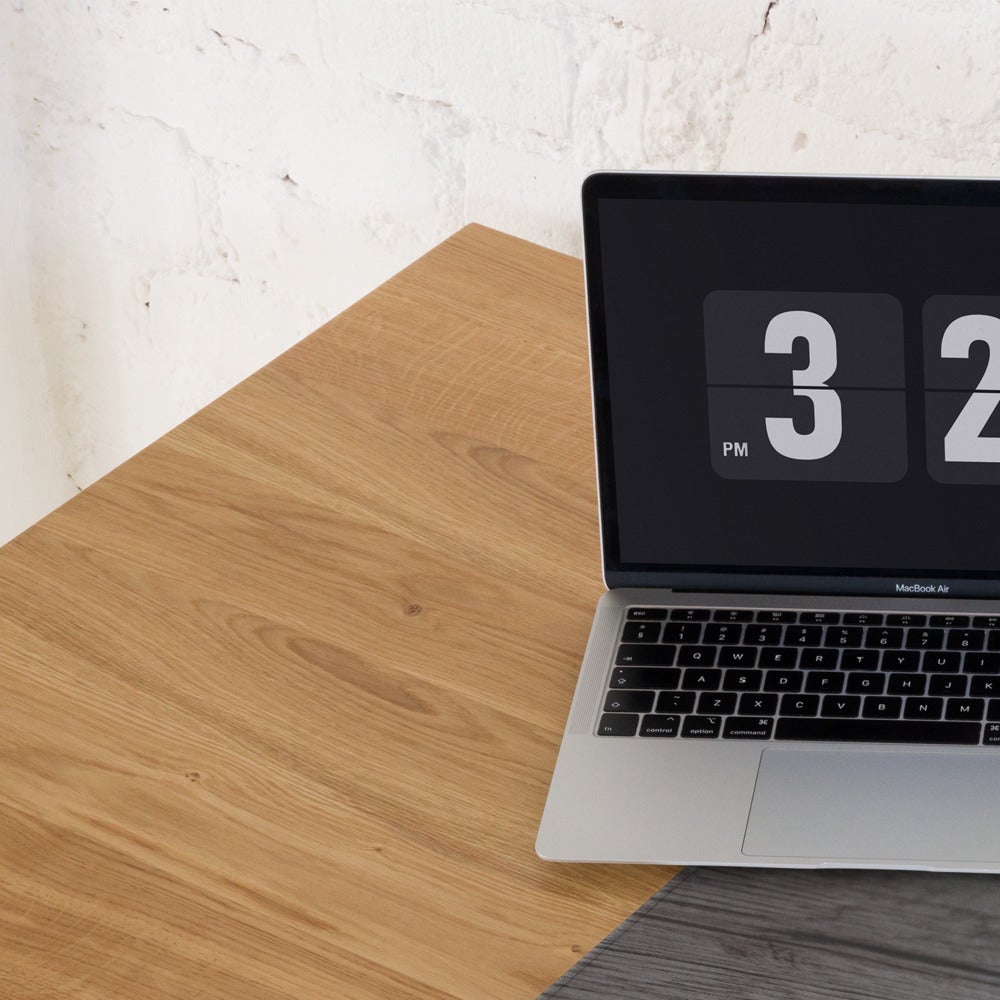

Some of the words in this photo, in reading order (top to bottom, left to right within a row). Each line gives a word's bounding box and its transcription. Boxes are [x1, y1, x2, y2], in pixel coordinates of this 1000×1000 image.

[764, 310, 843, 461] 3
[723, 441, 749, 457] PM
[895, 584, 936, 593] MacBook
[937, 584, 950, 593] Air
